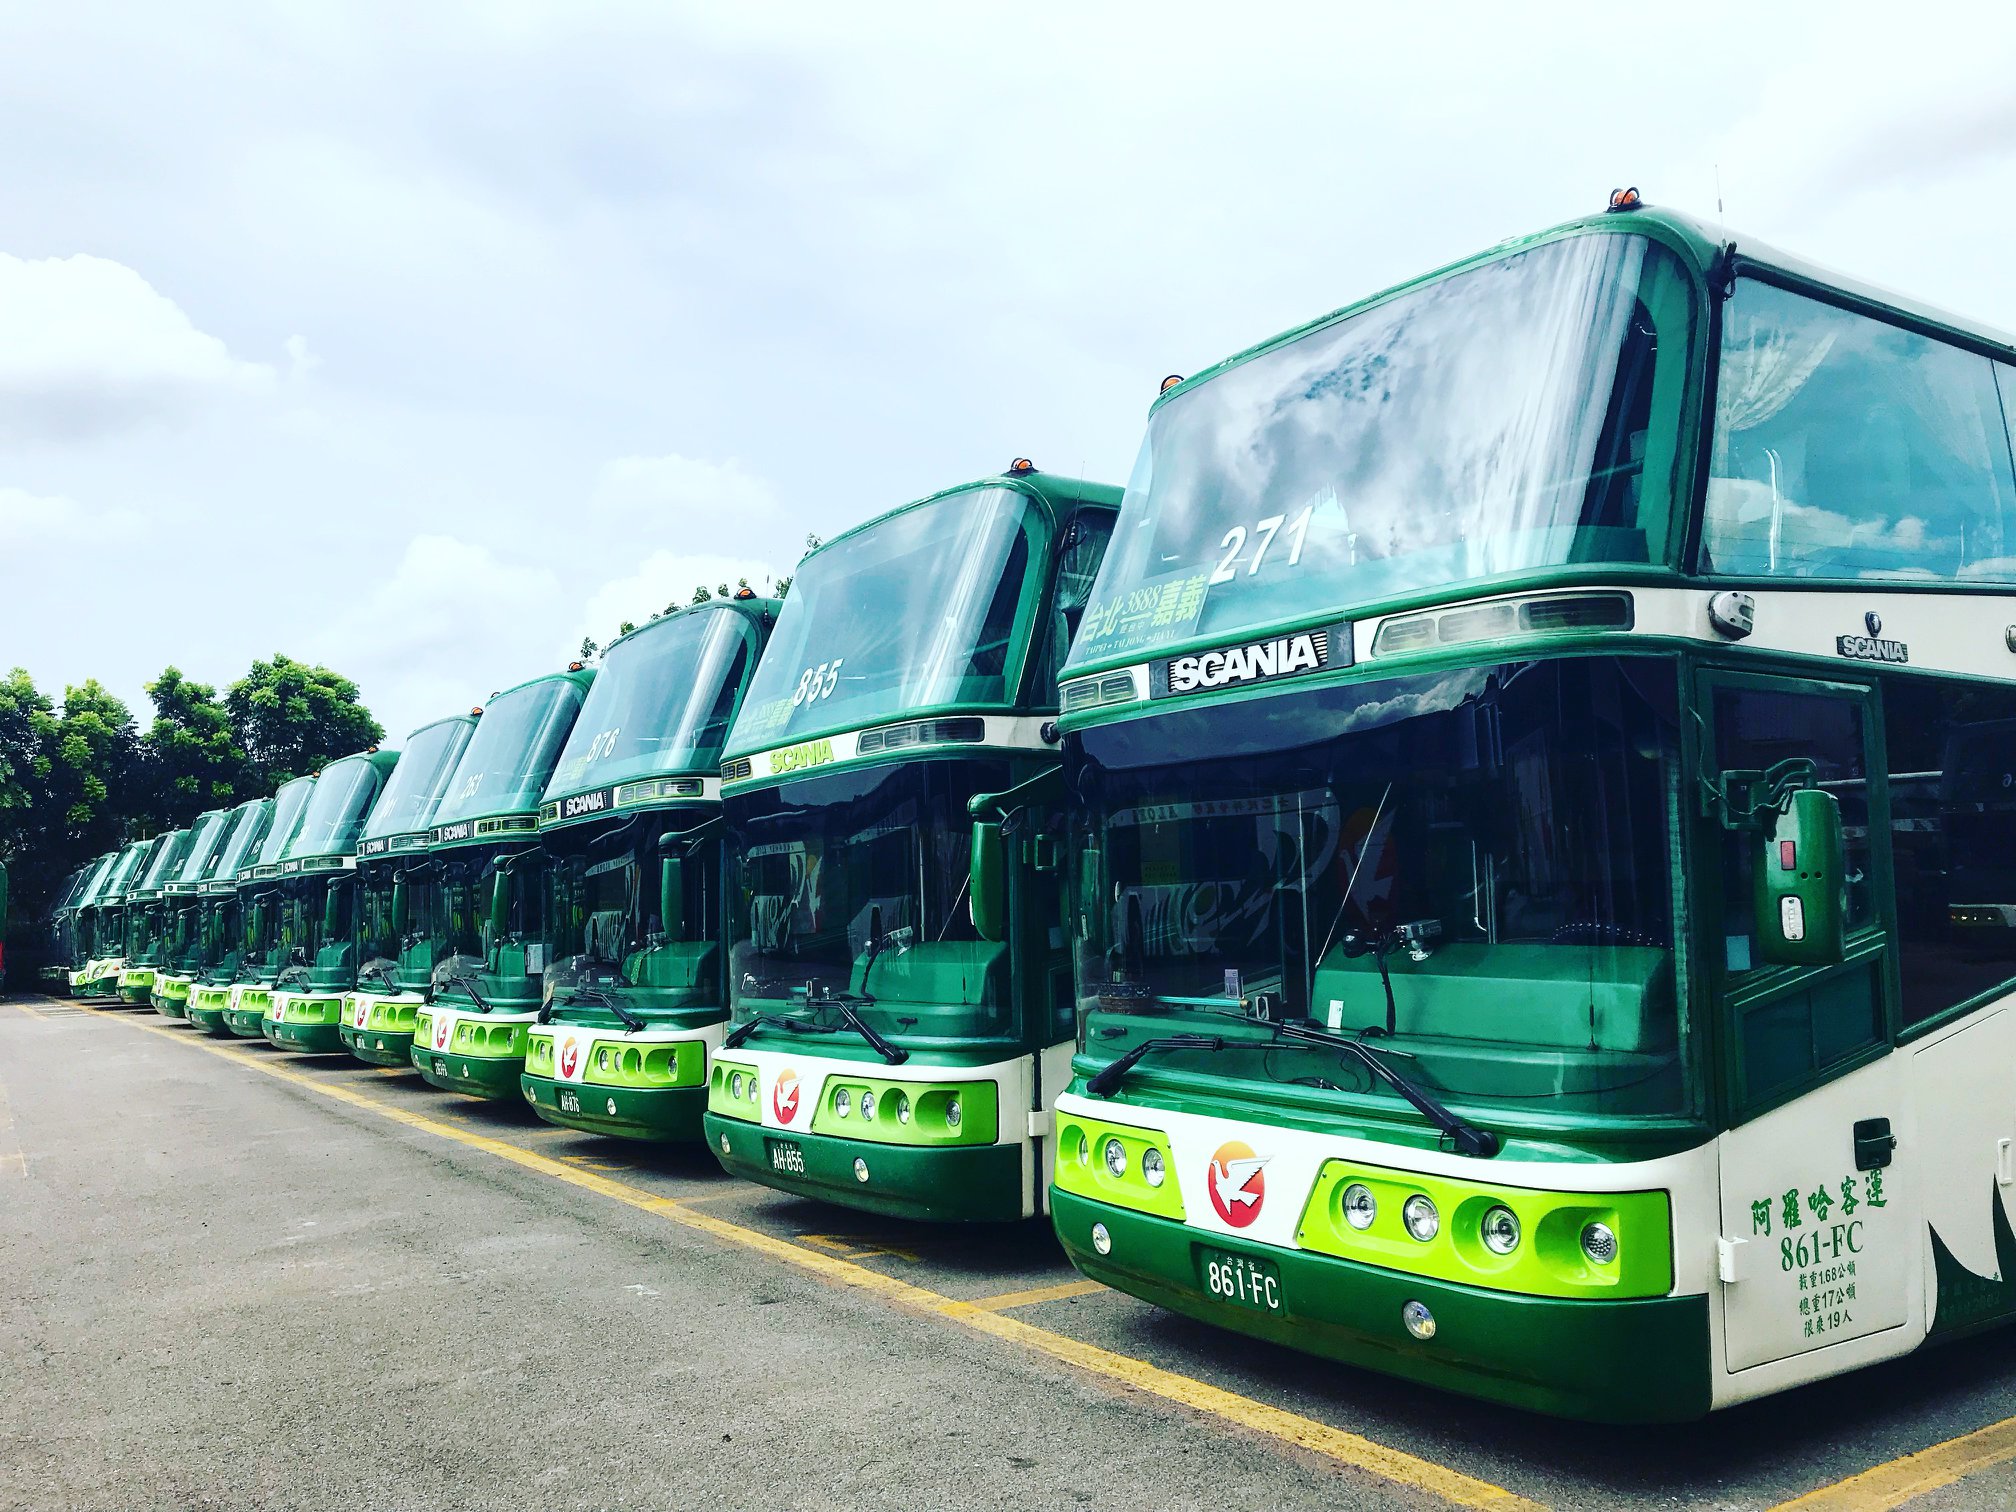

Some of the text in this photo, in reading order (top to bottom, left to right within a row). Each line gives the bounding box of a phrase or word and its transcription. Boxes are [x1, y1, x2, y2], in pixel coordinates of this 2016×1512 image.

[1209, 505, 1315, 587] 271
[1079, 573, 1208, 646] 台北 嘉義
[1122, 585, 1163, 616] 3888
[1174, 634, 1319, 691] SCANIA
[1843, 635, 1906, 662] SCANIA
[792, 658, 844, 708] 855
[587, 727, 622, 763] 876
[770, 740, 835, 774] SCANIA
[565, 791, 604, 816] SCANIA
[773, 1148, 805, 1173] AH-855
[1751, 1169, 1888, 1237] 阿羅哈客運
[1780, 1220, 1864, 1272] 861-FC
[1208, 1261, 1280, 1309] 861-FC
